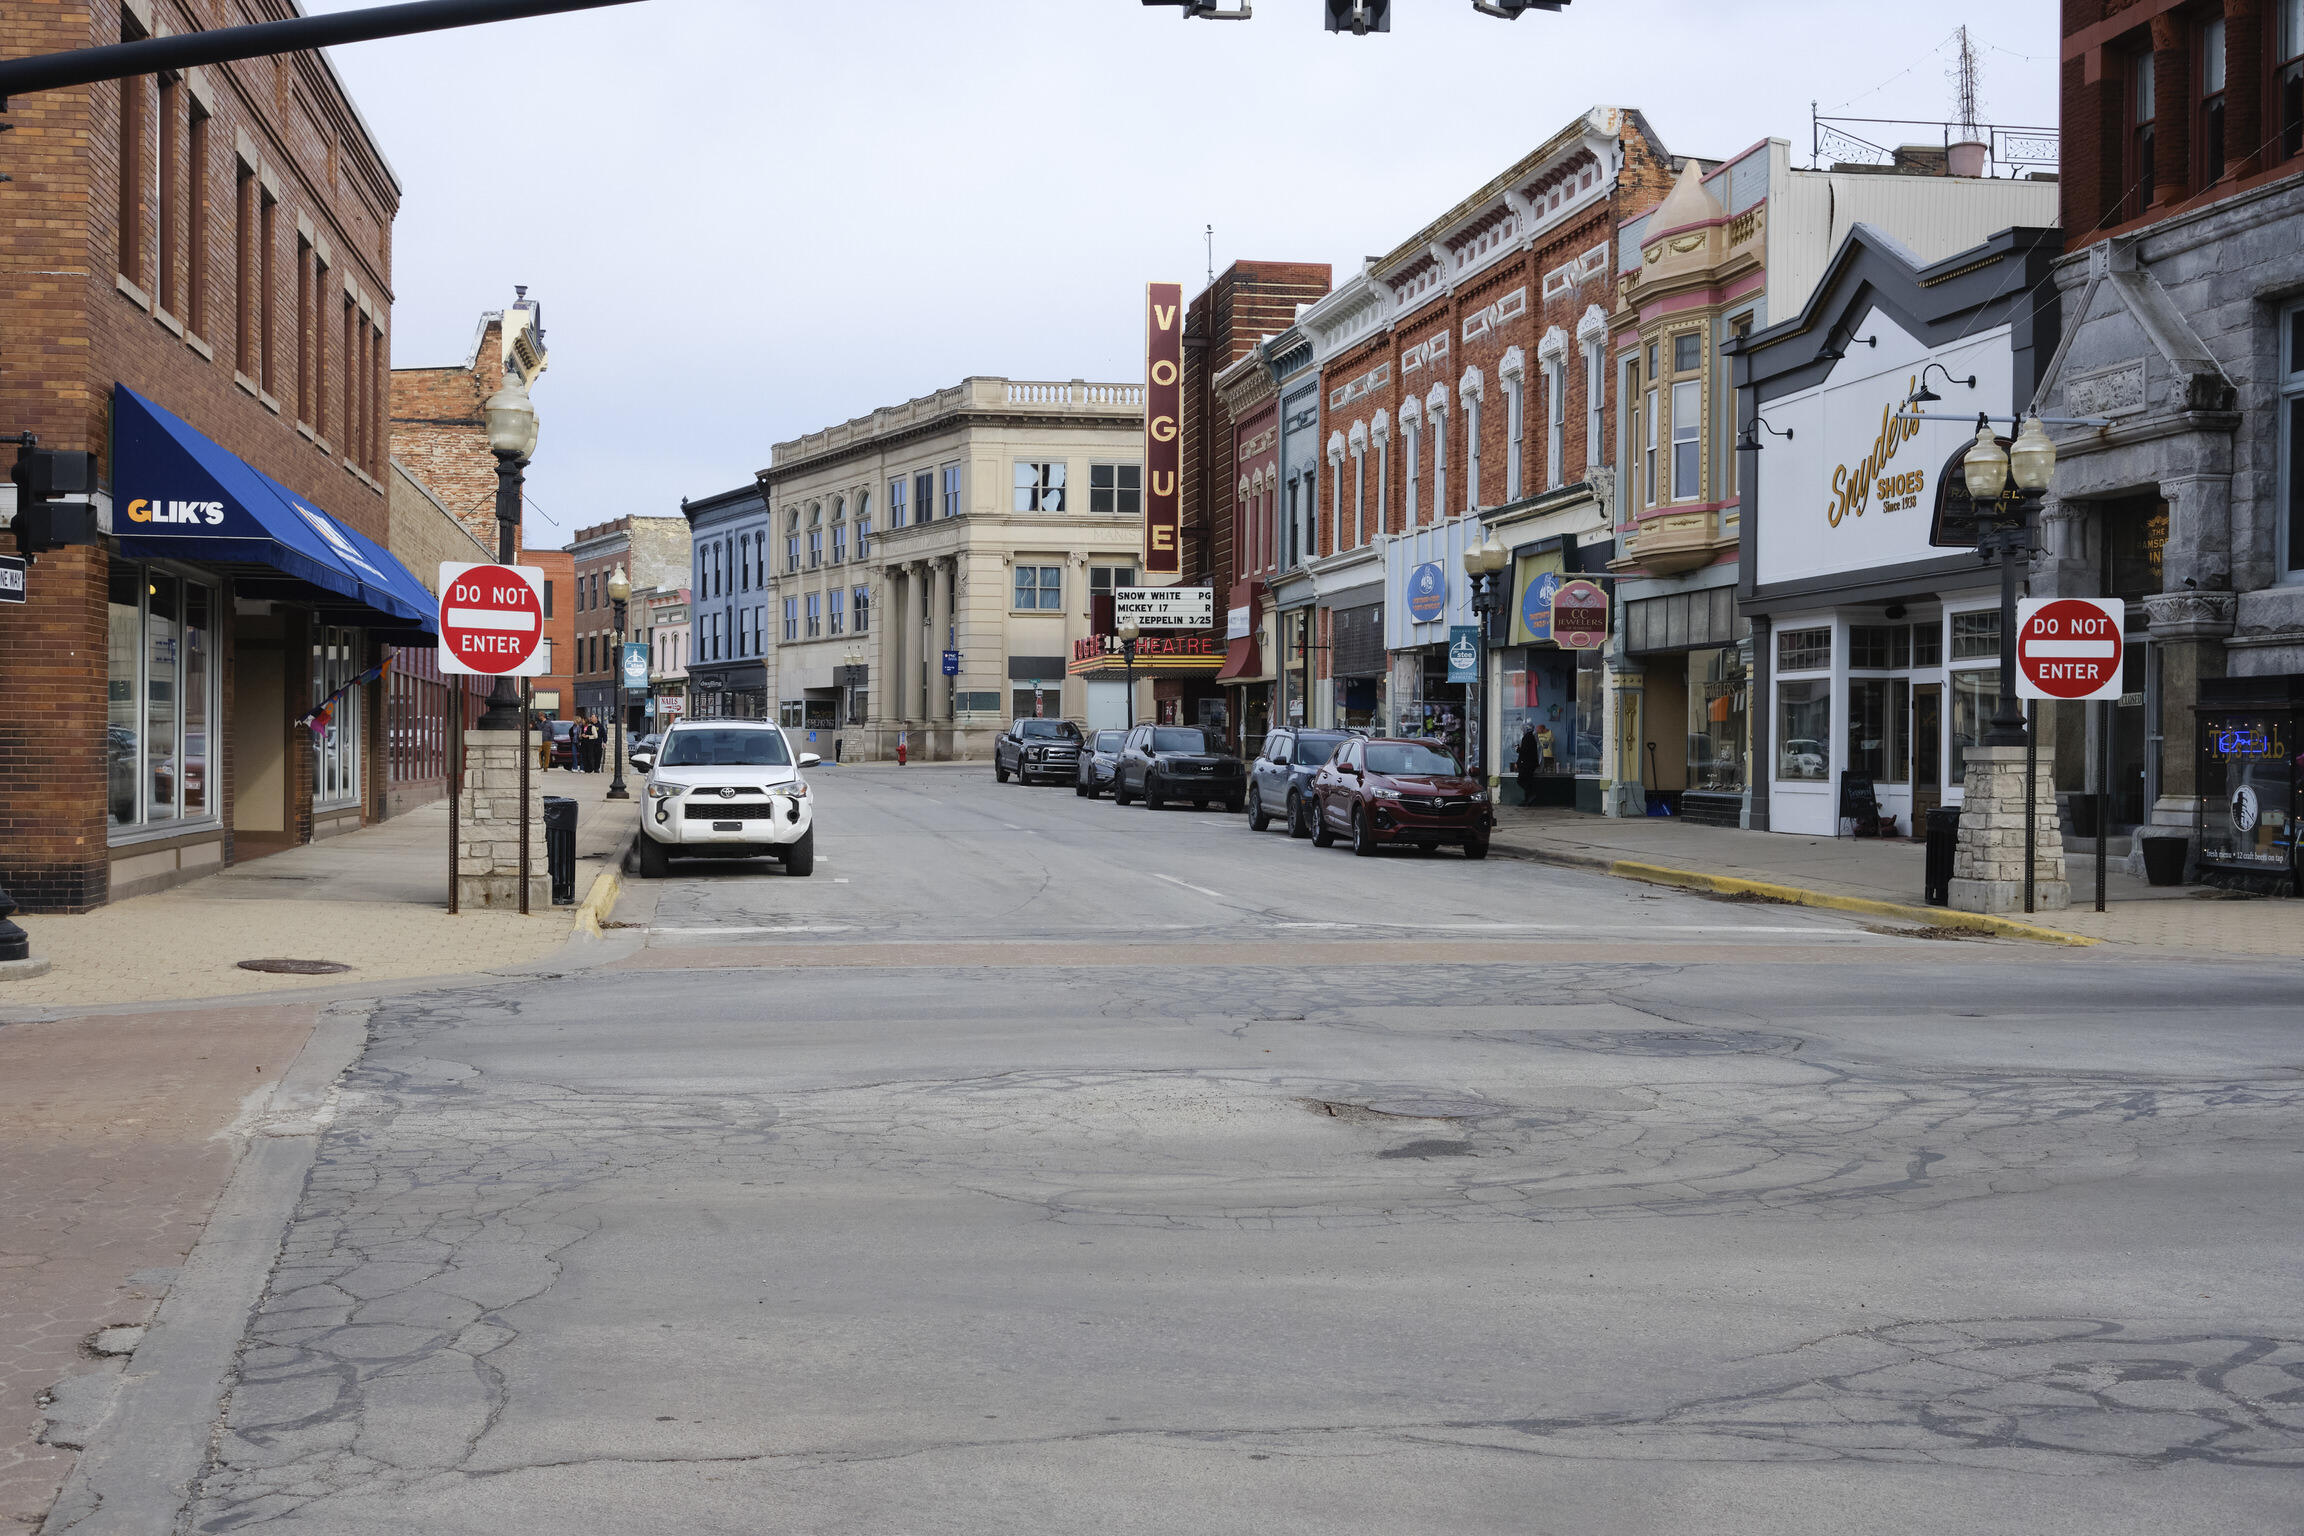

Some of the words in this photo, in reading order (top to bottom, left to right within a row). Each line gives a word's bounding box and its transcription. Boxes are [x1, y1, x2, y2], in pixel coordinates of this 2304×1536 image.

[1151, 304, 1178, 551] VOGUE
[1828, 374, 1925, 528] Snyder's
[1877, 469, 1924, 500] SHOES
[127, 498, 225, 525] GLIK'S
[1883, 501, 1901, 513] Since
[1902, 495, 1917, 510] 1938
[2152, 528, 2165, 536] THE
[9, 571, 22, 588] WAY
[456, 584, 481, 603] DO
[492, 586, 528, 605] NOT
[1117, 591, 1146, 600] SNOW
[1150, 591, 1181, 600] WHITE
[1198, 591, 1211, 600] PG
[1117, 604, 1153, 612] MICKEY
[1159, 604, 1168, 612] 17
[1205, 604, 1211, 612] R
[1571, 609, 1589, 619] CC
[1139, 616, 1183, 624] ZEPPELIN
[1189, 616, 1211, 624] 3/25
[1558, 618, 1603, 626] JEWELERS
[2033, 618, 2059, 634] DO
[2070, 618, 2108, 634] NOT
[462, 634, 520, 654] ENTER
[1135, 638, 1213, 654] HEATRE
[2039, 663, 2099, 679] ENTER
[661, 697, 678, 705] NAILS
[2122, 694, 2142, 705] CLOSED
[2249, 727, 2285, 759] Pub
